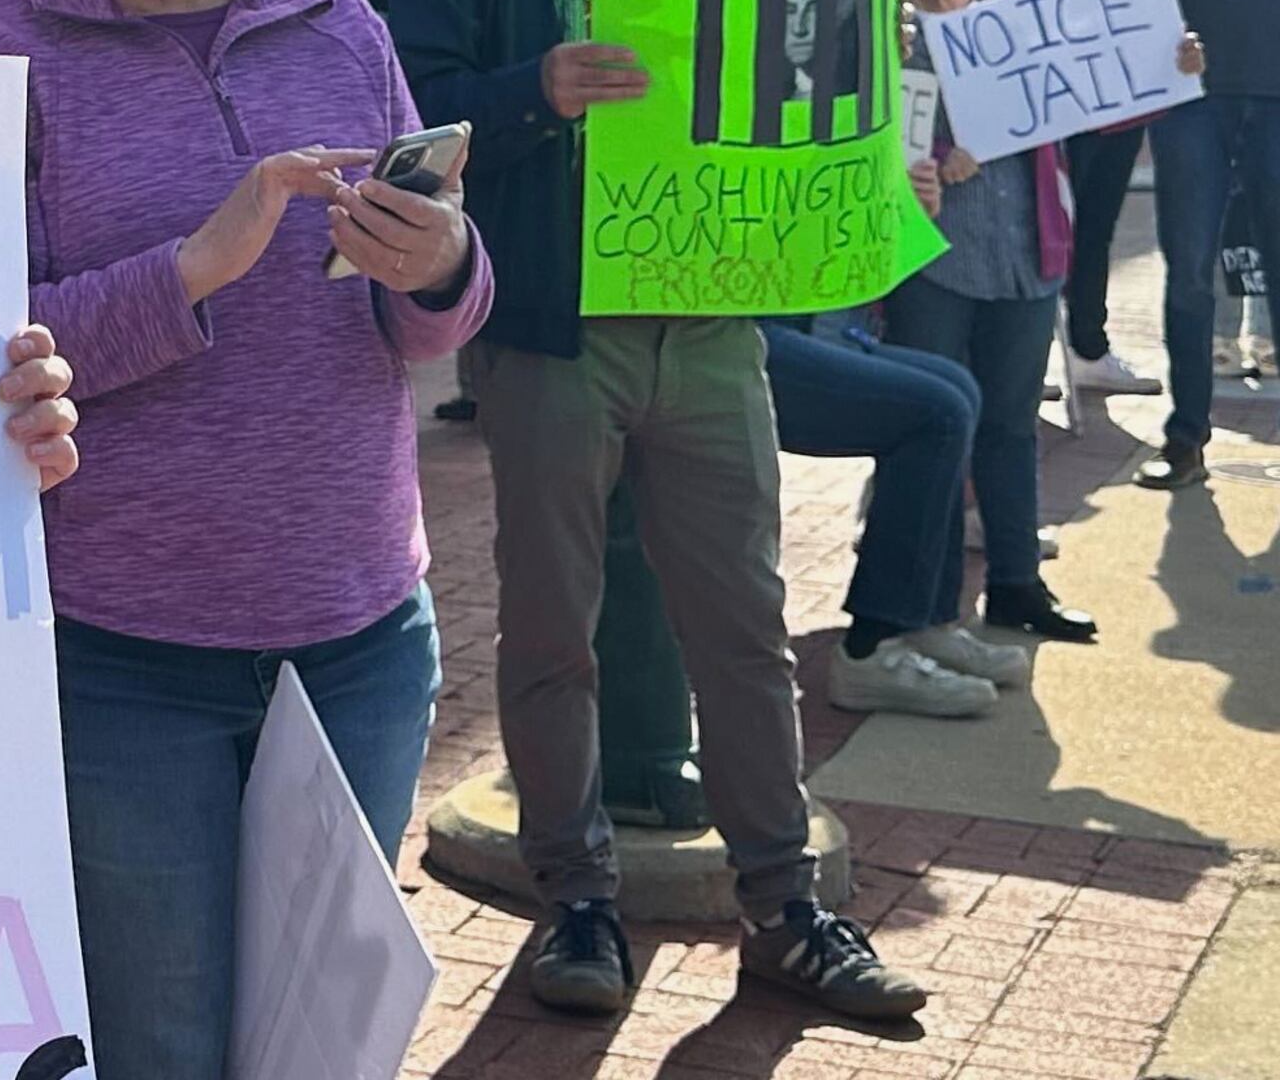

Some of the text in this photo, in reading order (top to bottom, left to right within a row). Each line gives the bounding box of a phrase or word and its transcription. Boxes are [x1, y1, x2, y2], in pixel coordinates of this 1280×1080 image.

[941, 10, 1016, 77] NO
[996, 46, 1168, 138] JAIL
[593, 213, 799, 259] COUNTY
[823, 209, 853, 255] IS
